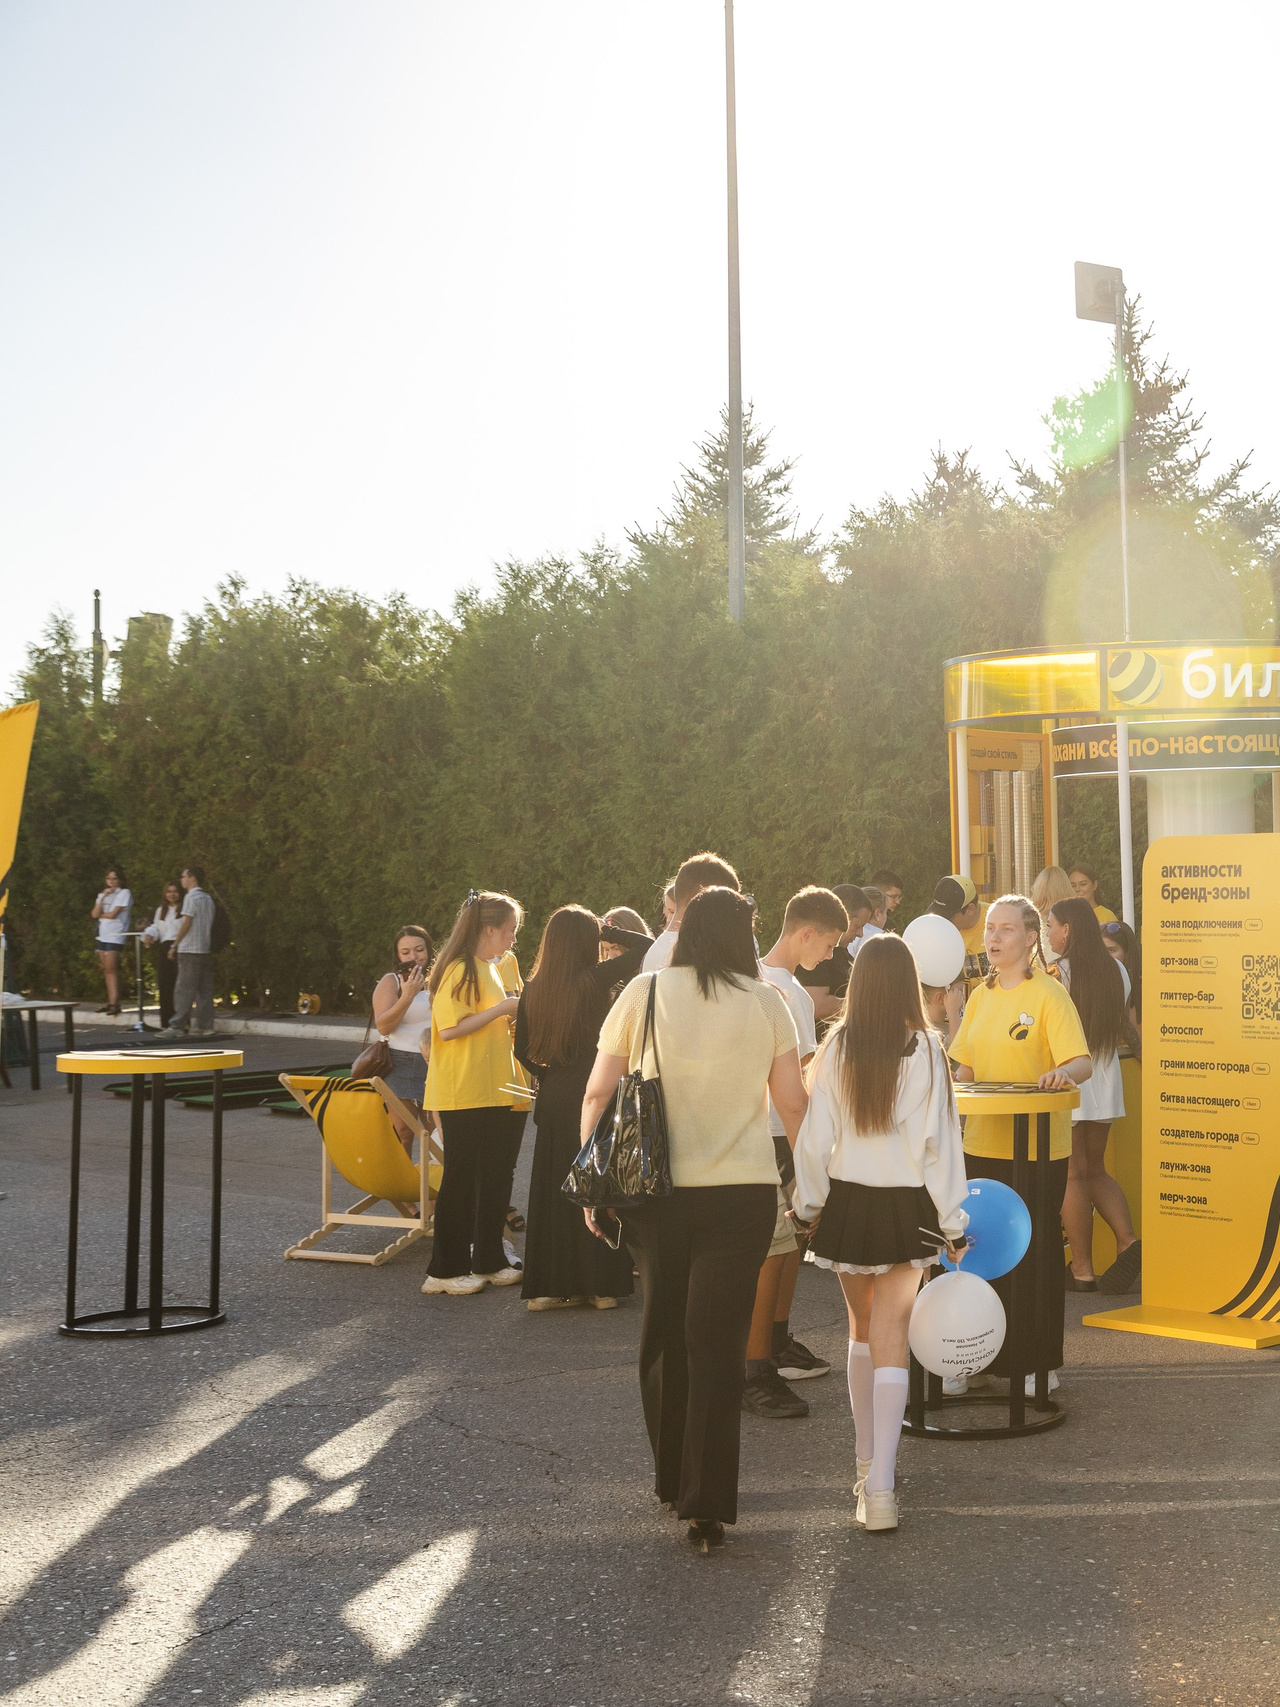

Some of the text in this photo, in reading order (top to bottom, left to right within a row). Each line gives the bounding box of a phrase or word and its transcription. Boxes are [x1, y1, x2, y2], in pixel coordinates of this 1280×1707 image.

[987, 748, 1000, 759] свой
[1001, 751, 1018, 760] стиль
[1161, 864, 1242, 879] активности
[1161, 883, 1250, 904] бренд-зоны
[1160, 919, 1243, 931] зона подключения
[1160, 956, 1199, 967] арт-зона
[1160, 990, 1215, 1004] глиттер-бар
[1160, 1023, 1204, 1037] фотоспот
[1160, 1059, 1250, 1074] грани моего города
[1160, 1092, 1241, 1109] битва настоящего
[1160, 1127, 1240, 1144] создатель города
[1160, 1161, 1211, 1174] лаунж-зона
[1160, 1192, 1208, 1205] мерч-зона
[942, 1348, 995, 1365] КОНСИЛИУМ
